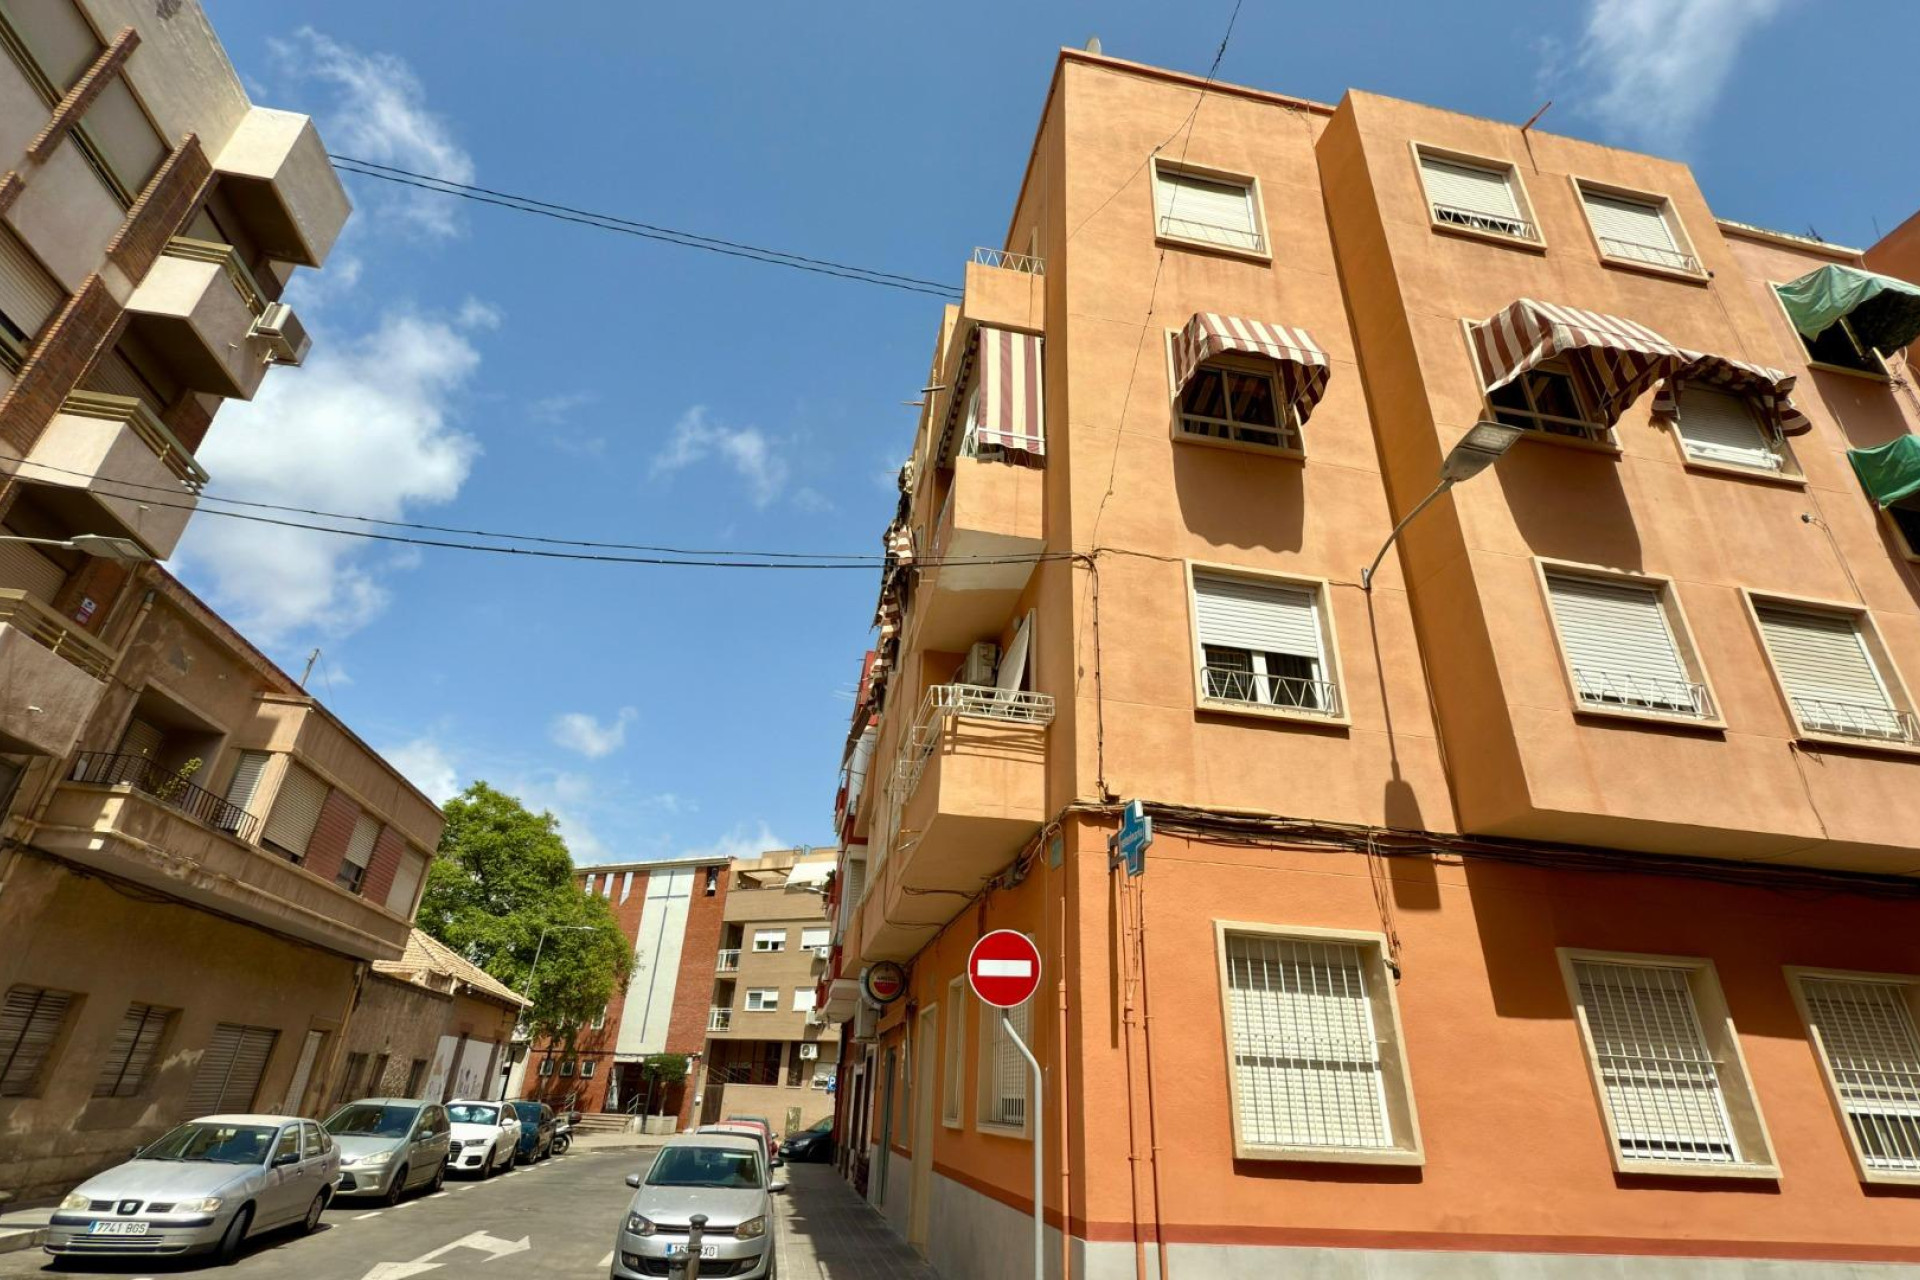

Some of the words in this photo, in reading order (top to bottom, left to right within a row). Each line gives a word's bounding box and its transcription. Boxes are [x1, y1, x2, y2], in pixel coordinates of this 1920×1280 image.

[829, 1076, 836, 1088] P
[97, 1222, 122, 1233] 7741
[125, 1223, 146, 1234] BGS
